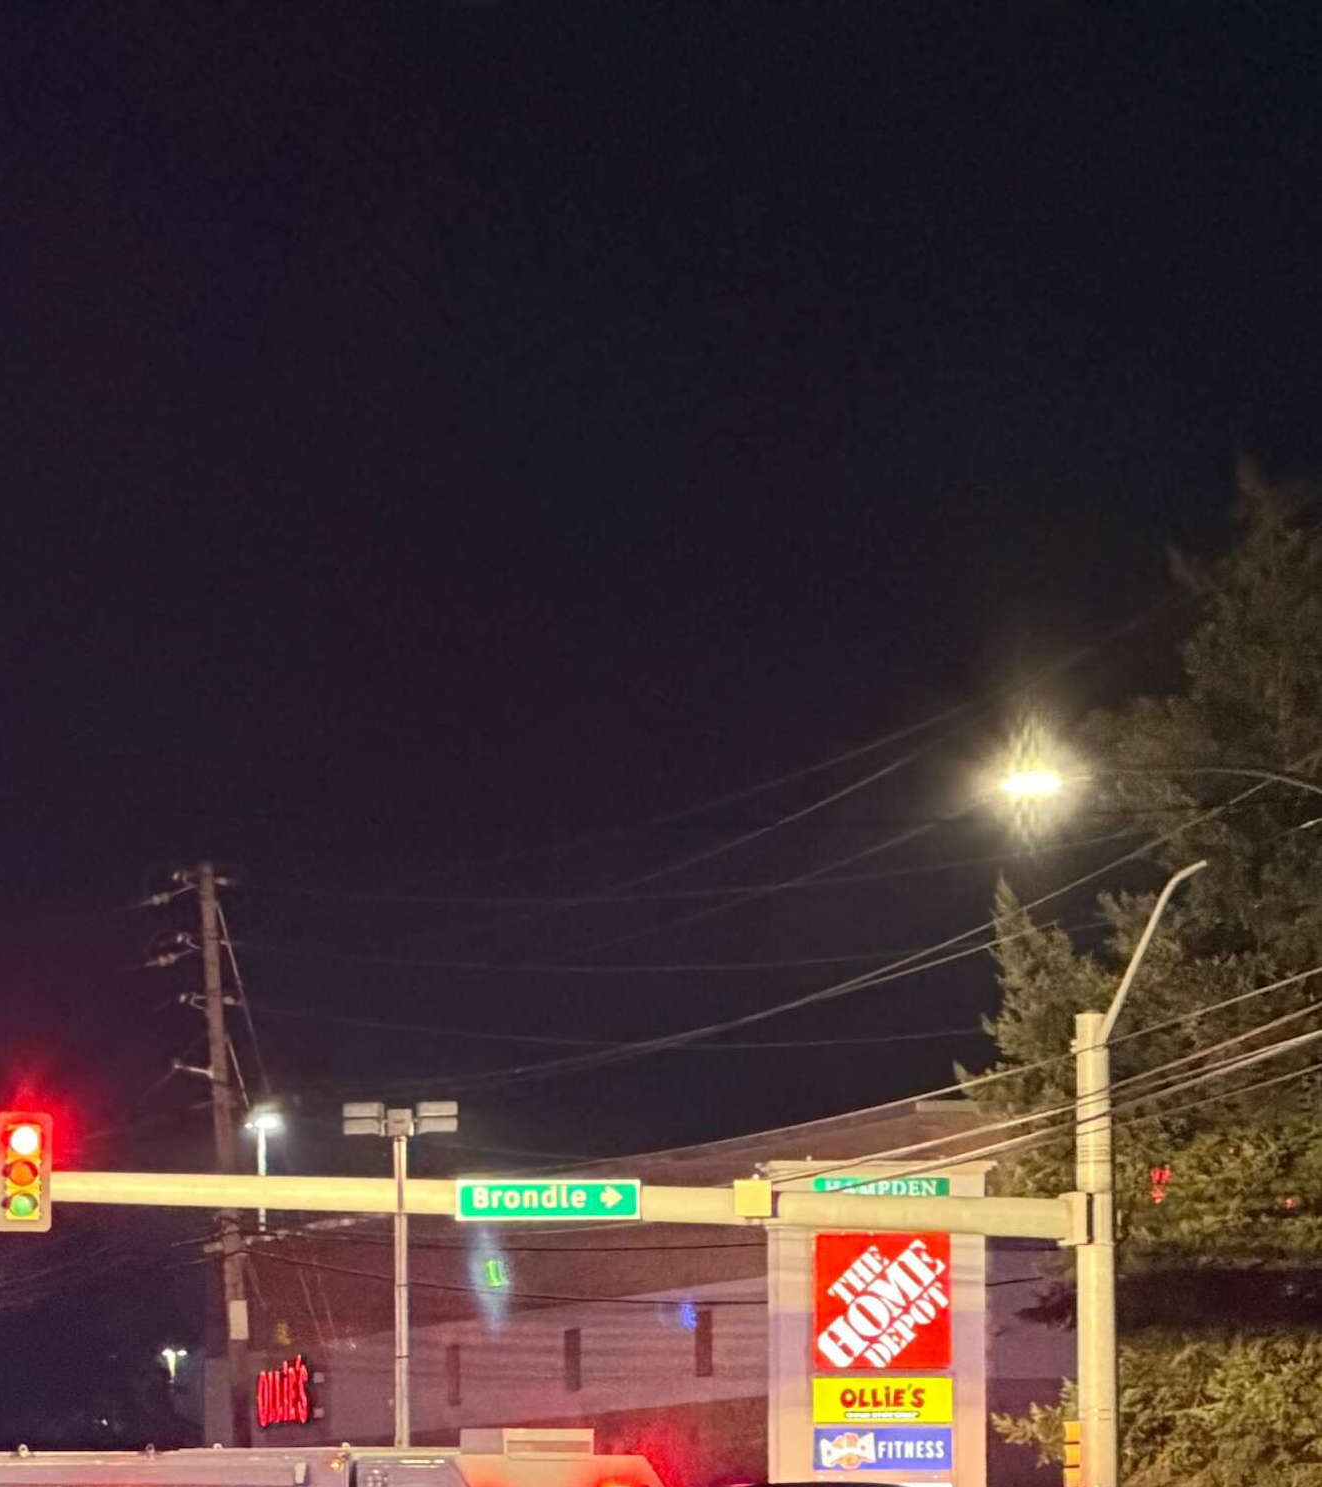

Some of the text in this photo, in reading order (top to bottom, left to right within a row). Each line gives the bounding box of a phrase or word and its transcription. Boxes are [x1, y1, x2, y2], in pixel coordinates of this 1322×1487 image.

[472, 1186, 587, 1209] Brondle
[818, 1239, 946, 1368] HOME
[827, 1245, 890, 1304] THE
[864, 1282, 949, 1368] DEPOT
[878, 1440, 945, 1459] FITNESS
